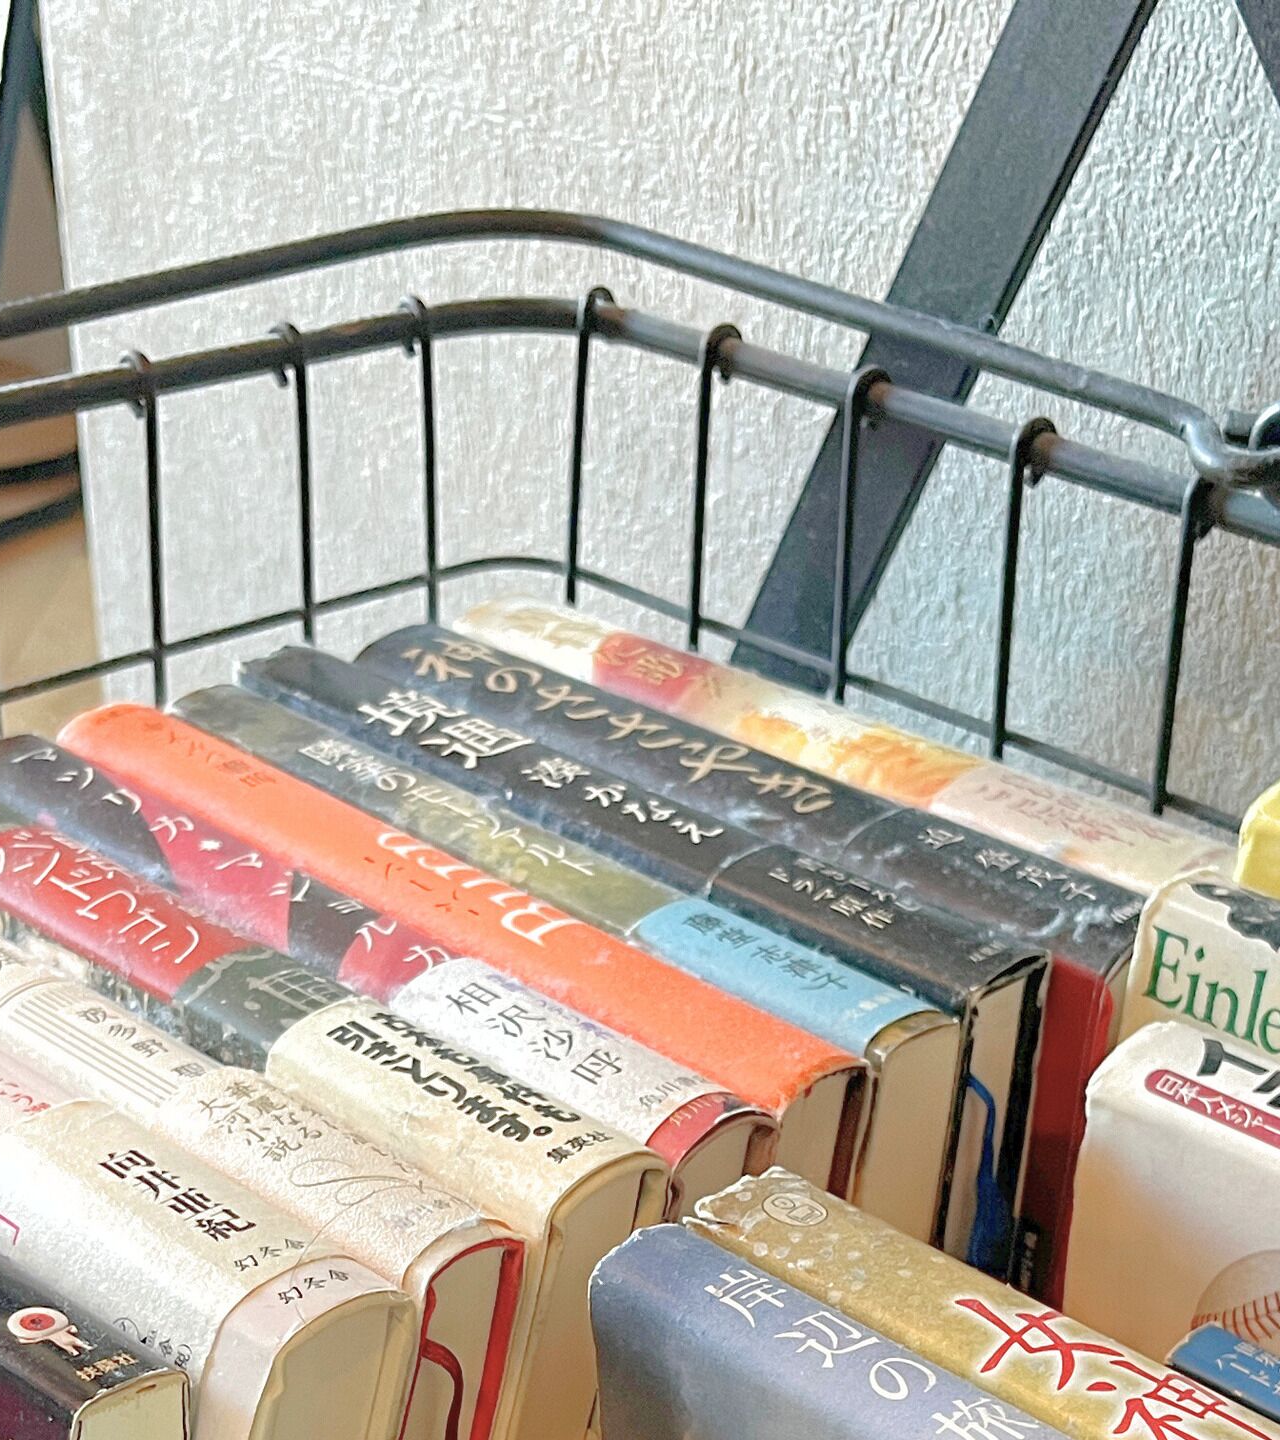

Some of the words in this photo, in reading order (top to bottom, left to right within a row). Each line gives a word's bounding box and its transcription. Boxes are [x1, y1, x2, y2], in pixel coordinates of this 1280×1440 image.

[357, 690, 534, 770] 境遇
[521, 758, 723, 844] 湊かなえ
[402, 637, 833, 813] 神のささやき
[297, 738, 595, 876] 隣室のモーツァルト
[11, 748, 453, 977] マツリカ・マジョルカ
[767, 866, 894, 931] ドラマ原作
[326, 1019, 556, 1144] 引きとります。
[370, 1011, 583, 1124] 古本も事件も
[445, 981, 625, 1085] 相沢沙呼
[199, 1091, 304, 1164] 大河小説
[545, 1130, 615, 1166] 集英社
[96, 1149, 257, 1244] 向井亜紀
[233, 1237, 307, 1273] 幻冬舎
[277, 1268, 351, 1305] 幻冬舎
